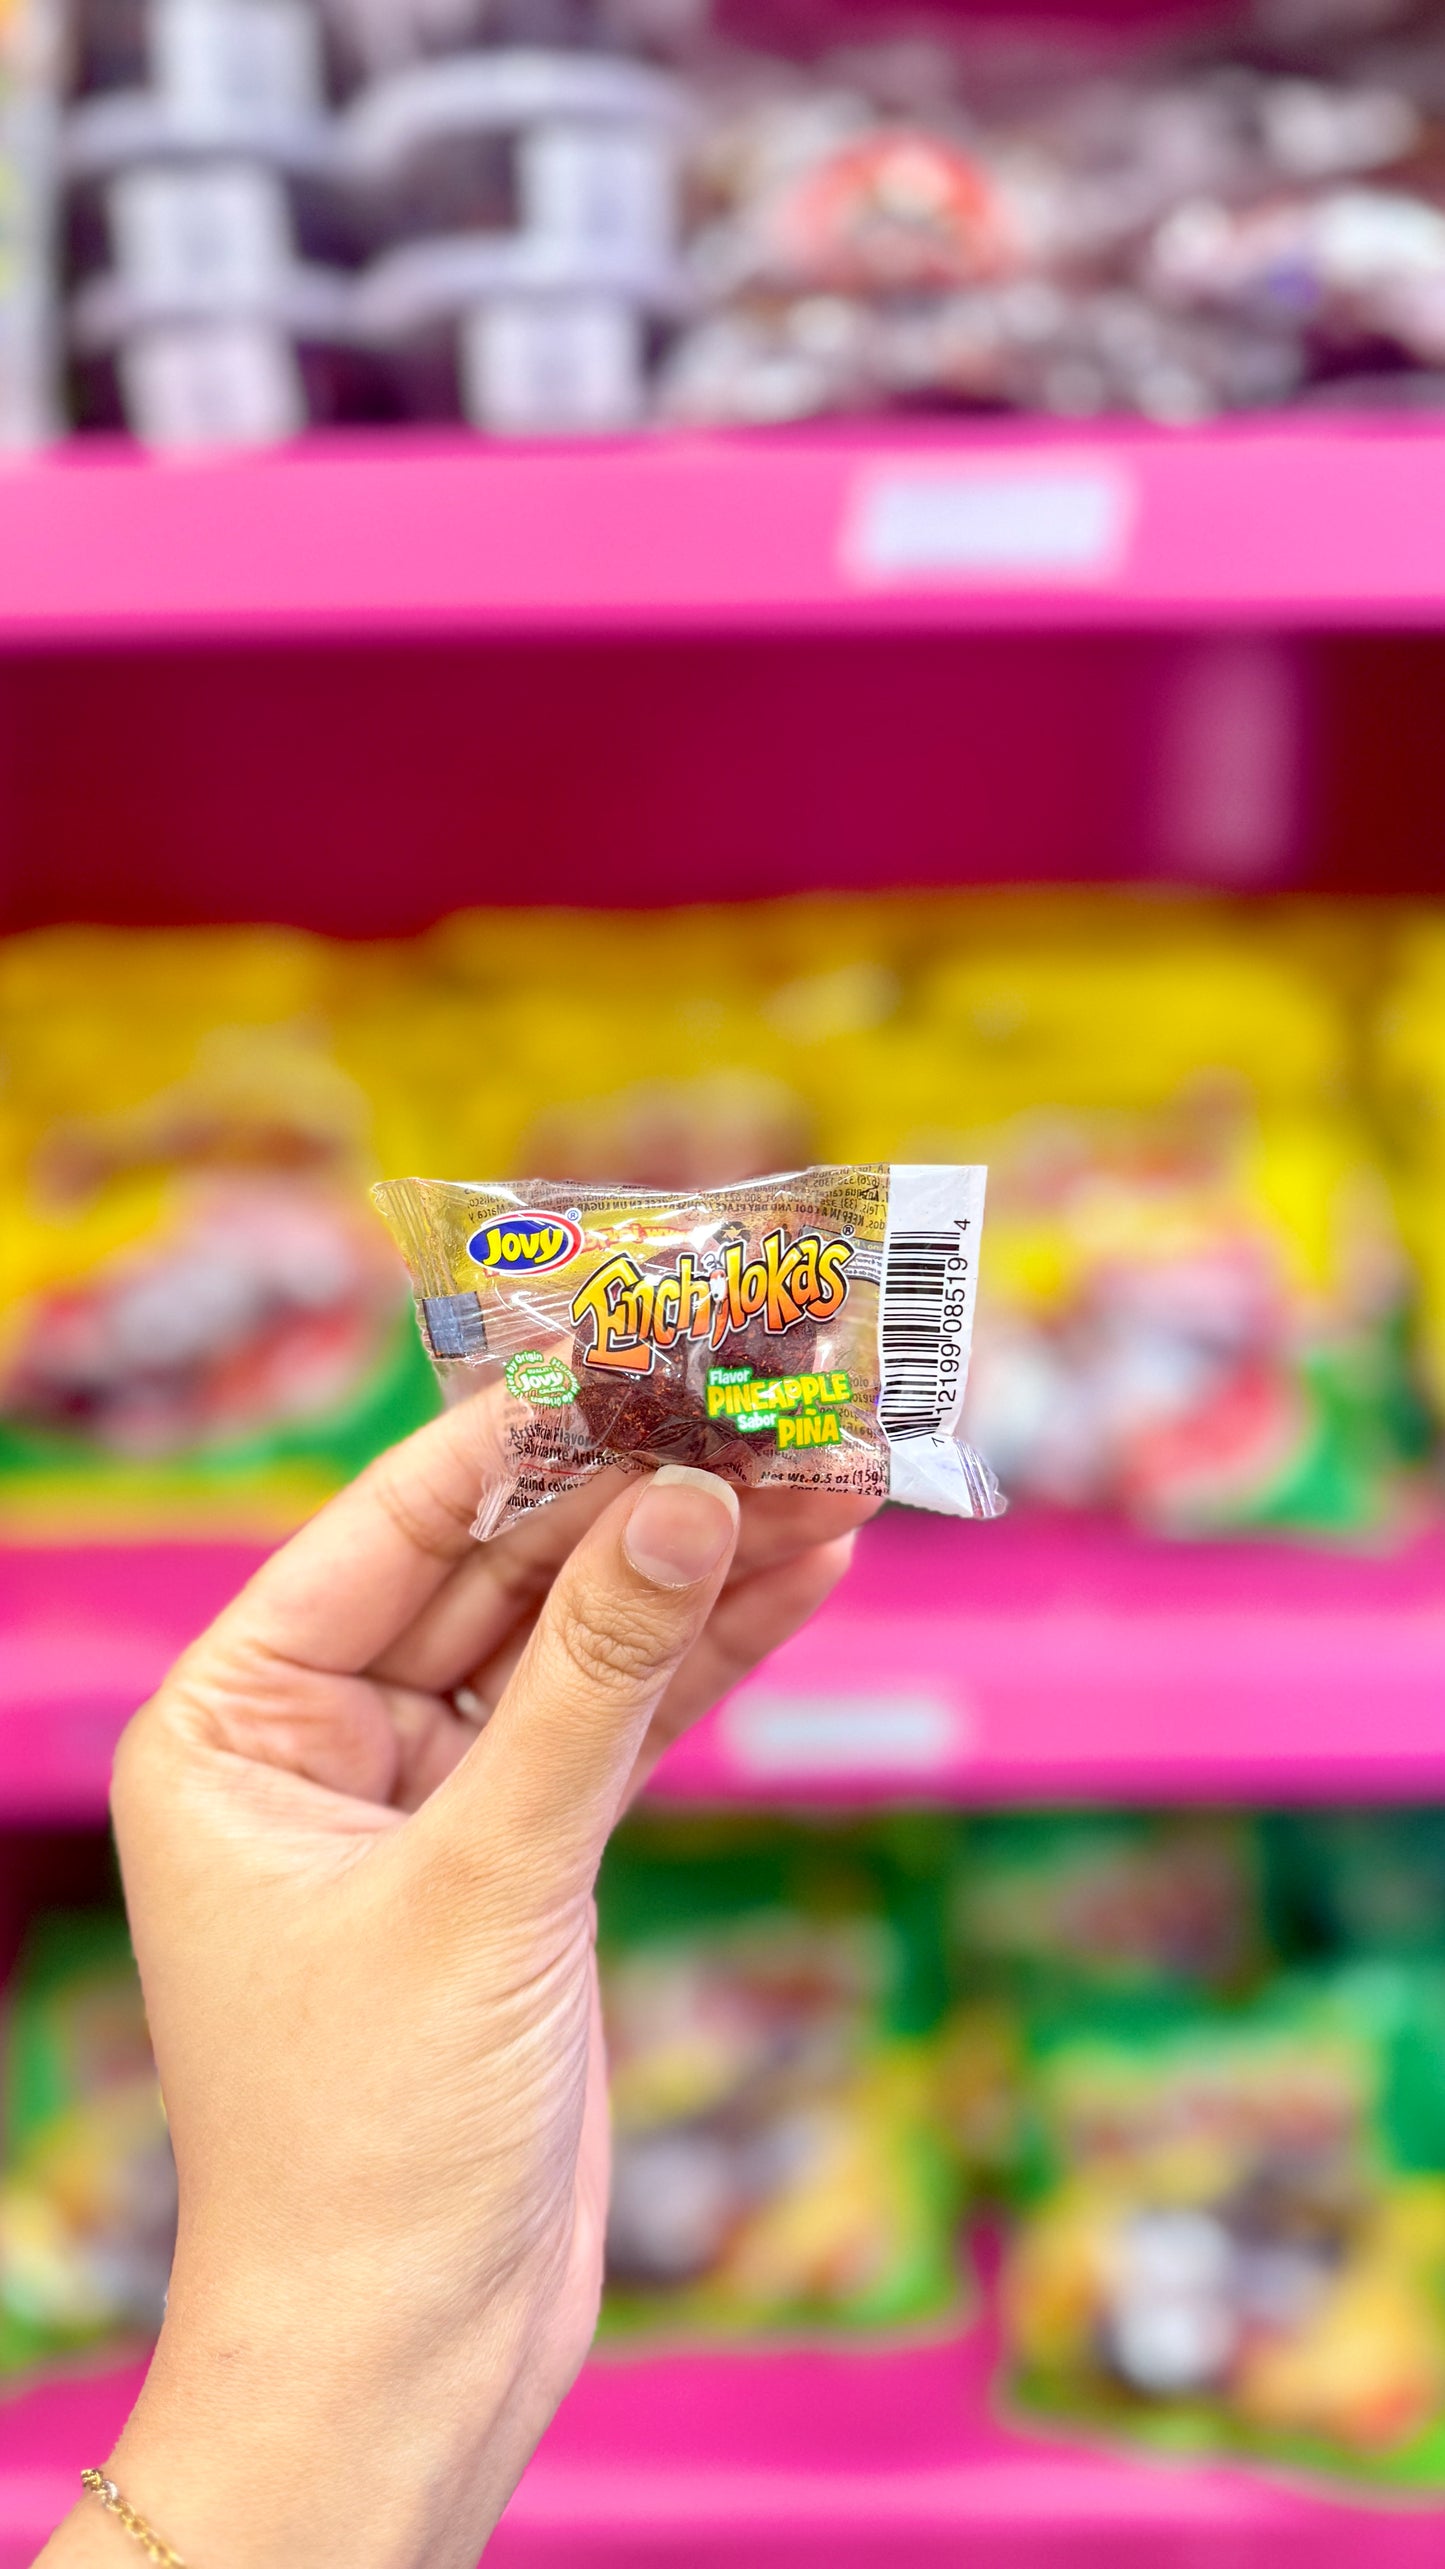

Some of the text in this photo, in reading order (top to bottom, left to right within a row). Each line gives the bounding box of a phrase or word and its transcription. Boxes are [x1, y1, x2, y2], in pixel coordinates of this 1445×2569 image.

[954, 1218, 971, 1231] 4
[482, 1227, 565, 1267] Jovy
[571, 1227, 855, 1376] Enchilokas
[942, 1257, 969, 1333] 08519
[519, 1371, 564, 1391] Jovy
[707, 1373, 851, 1418] PINEAPPLE
[709, 1369, 750, 1386] Flavor
[934, 1343, 962, 1415] 12199
[736, 1412, 777, 1430] Sabor
[778, 1408, 840, 1449] PIÑA
[811, 1471, 832, 1485] 0.5
[835, 1474, 850, 1485] oz
